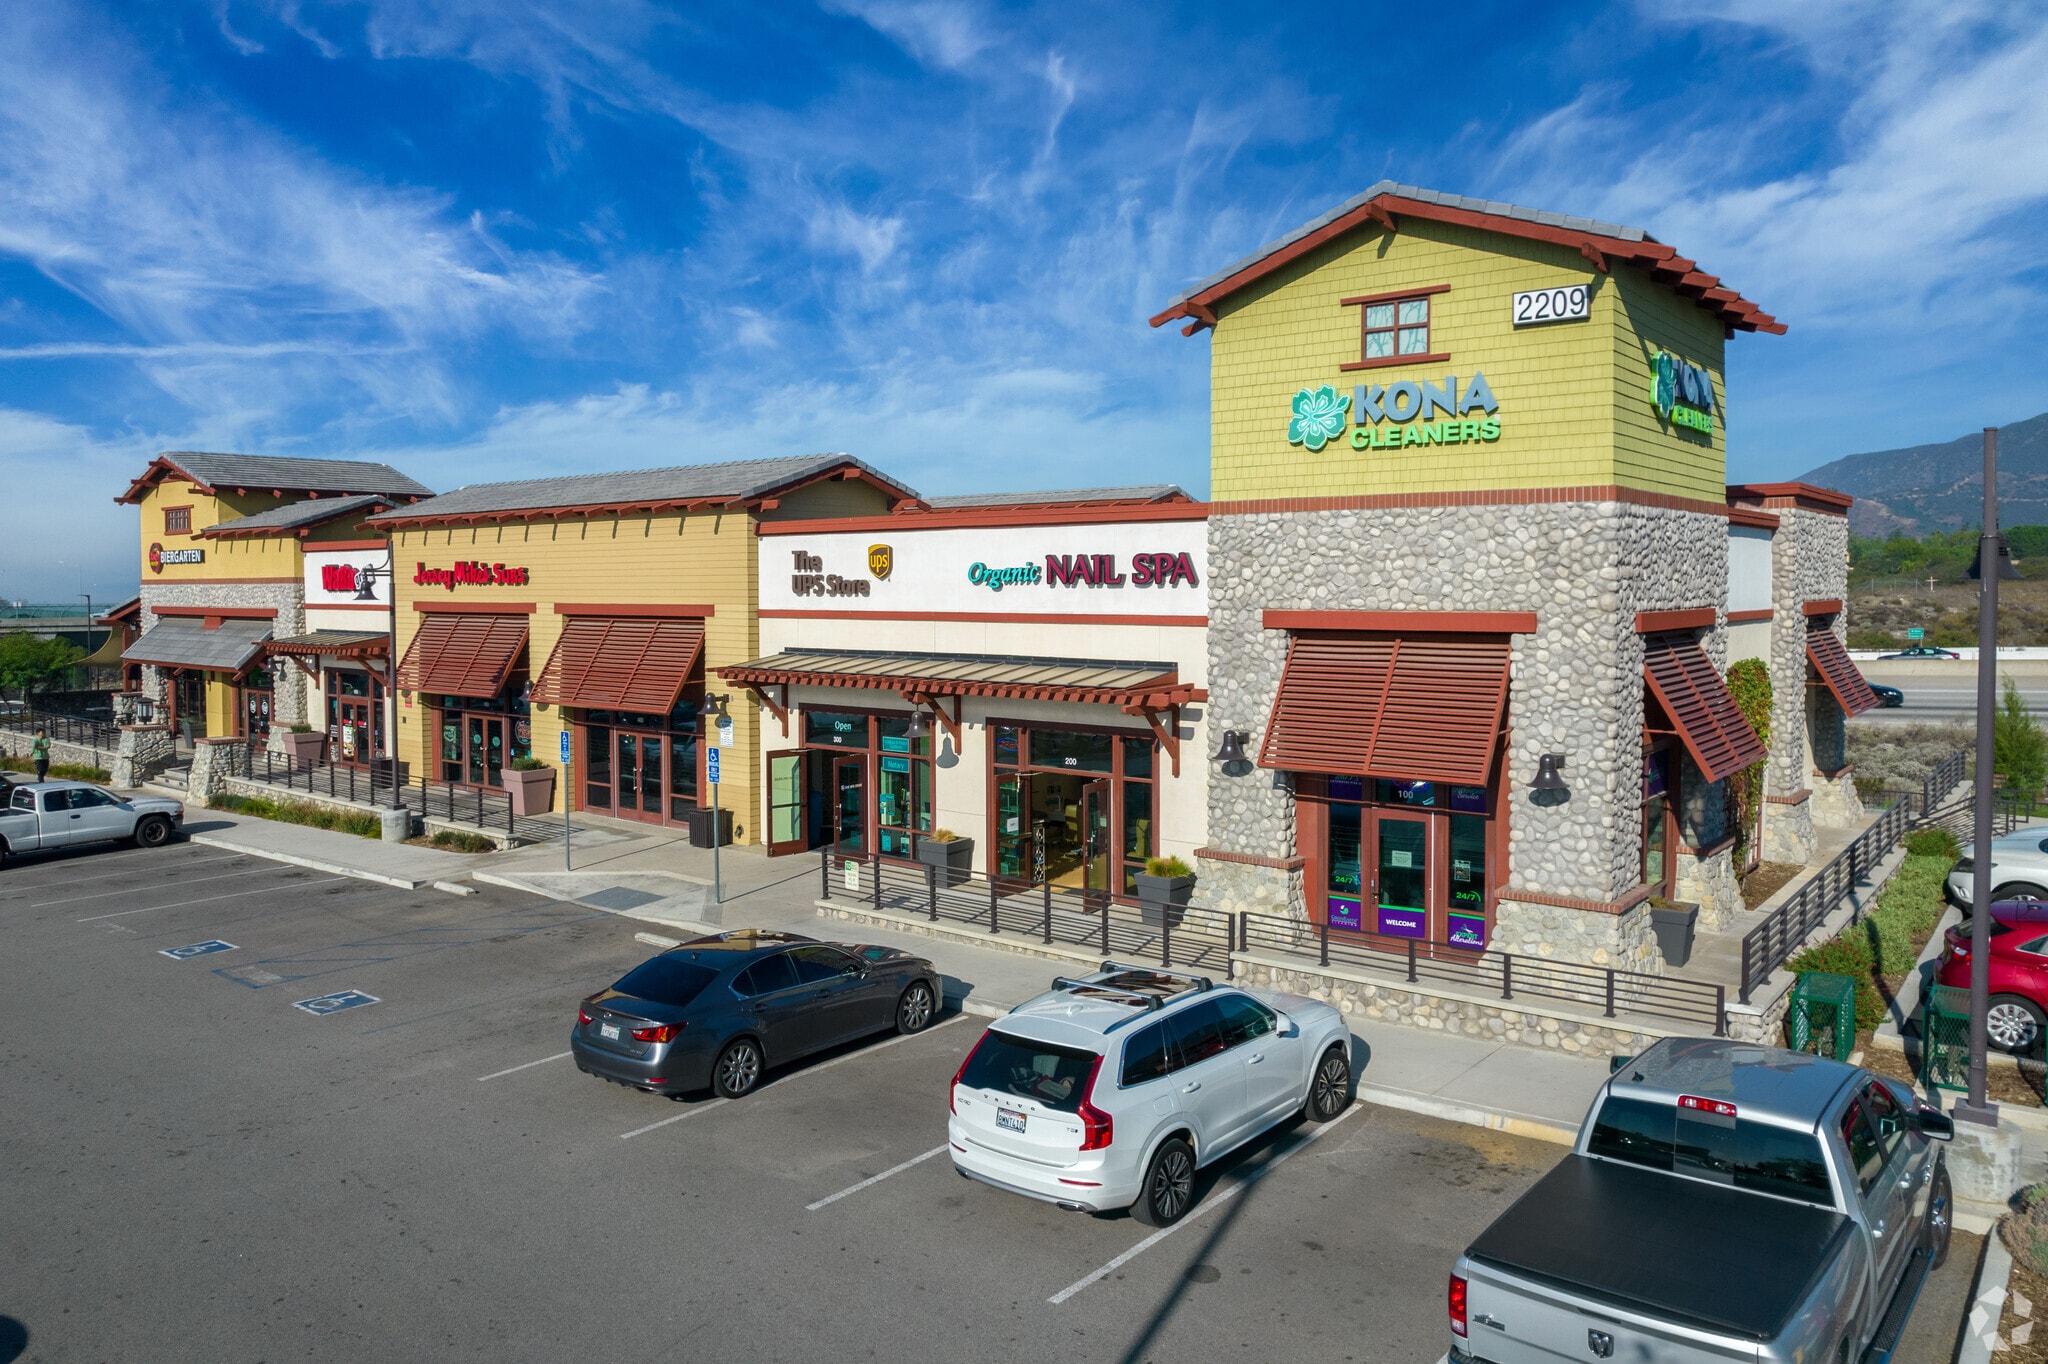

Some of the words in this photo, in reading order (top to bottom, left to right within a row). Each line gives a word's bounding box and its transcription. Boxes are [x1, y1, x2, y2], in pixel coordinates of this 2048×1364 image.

[1517, 288, 1585, 321] 2209
[1353, 370, 1499, 426] KONA
[1350, 418, 1501, 450] CLEANERS
[160, 549, 202, 563] BIERGARTEN
[791, 550, 822, 572] The
[870, 554, 888, 573] ups
[413, 561, 451, 590] Jersey
[453, 560, 491, 583] Mike's
[968, 561, 1040, 591] Organic
[1045, 554, 1124, 587] NAIL
[1131, 551, 1198, 587] SPA
[791, 573, 825, 597] UPS
[826, 573, 871, 597] Store
[834, 720, 852, 732] Open
[887, 761, 905, 771] Notary
[1065, 757, 1077, 765] 200
[1398, 790, 1414, 799] 100
[1335, 875, 1353, 884] 24/7
[1455, 891, 1476, 901] 24/7
[1385, 918, 1417, 928] WELCOME
[1450, 934, 1483, 946] Alterations
[983, 1094, 1036, 1112] VOLVO
